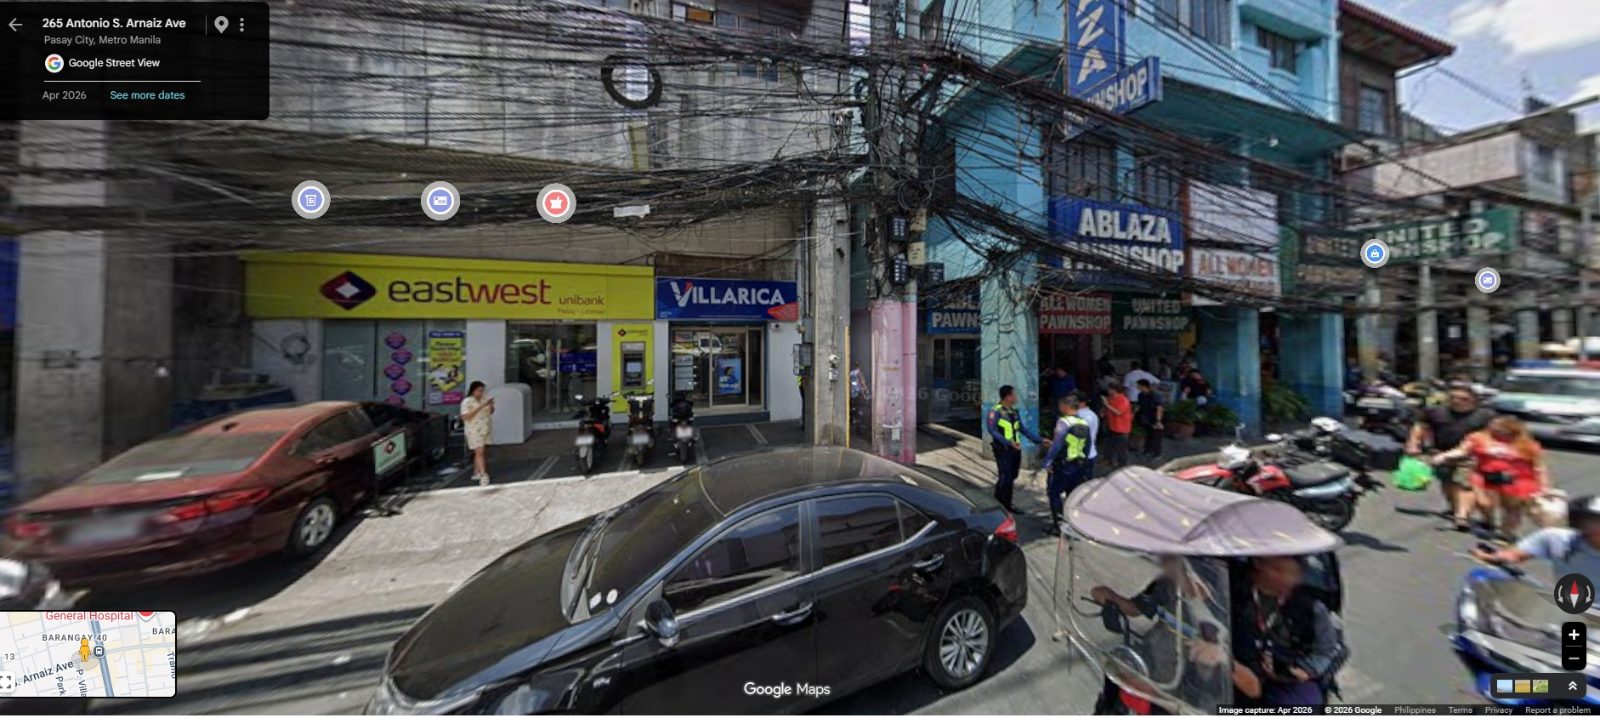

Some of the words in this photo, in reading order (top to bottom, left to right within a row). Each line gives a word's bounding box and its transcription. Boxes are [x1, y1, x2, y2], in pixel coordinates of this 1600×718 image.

[1079, 207, 1172, 243] ABLAZA
[388, 276, 552, 304] eastwest
[670, 280, 785, 307] VILLARICA
[559, 295, 605, 305] unibank
[944, 293, 980, 310] ABL
[1040, 296, 1065, 311] ALL
[1066, 296, 1112, 311] WOMEN
[1132, 298, 1181, 314] UNITED
[1040, 315, 1112, 330] PAWNSHOP
[1123, 316, 1189, 330] PAWNSHOP
